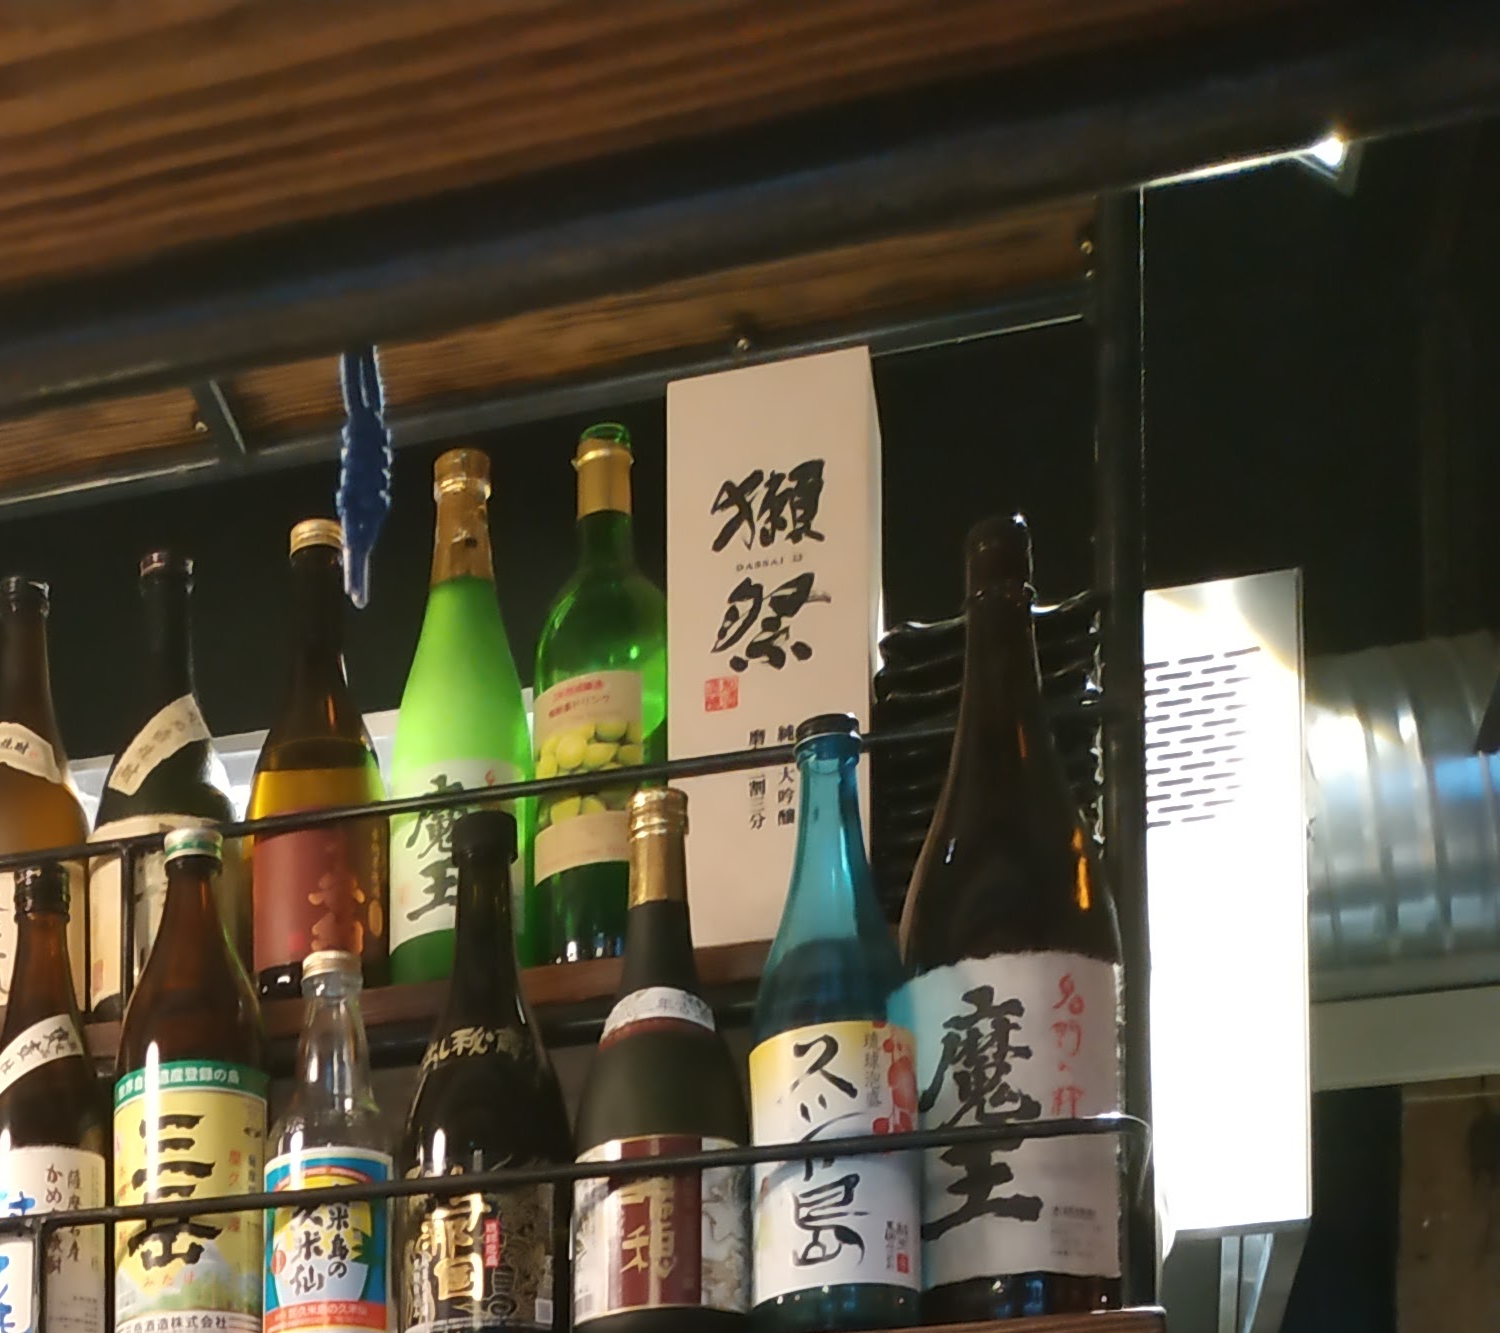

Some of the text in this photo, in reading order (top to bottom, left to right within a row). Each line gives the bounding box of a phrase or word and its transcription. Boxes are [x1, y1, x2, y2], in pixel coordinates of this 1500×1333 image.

[710, 459, 832, 672] 獺祭
[736, 556, 784, 572] DASSAI
[777, 724, 795, 826] 純大吟醸
[118, 1067, 240, 1101] 世界自遺産登録の島
[920, 985, 1042, 1241] 魔王
